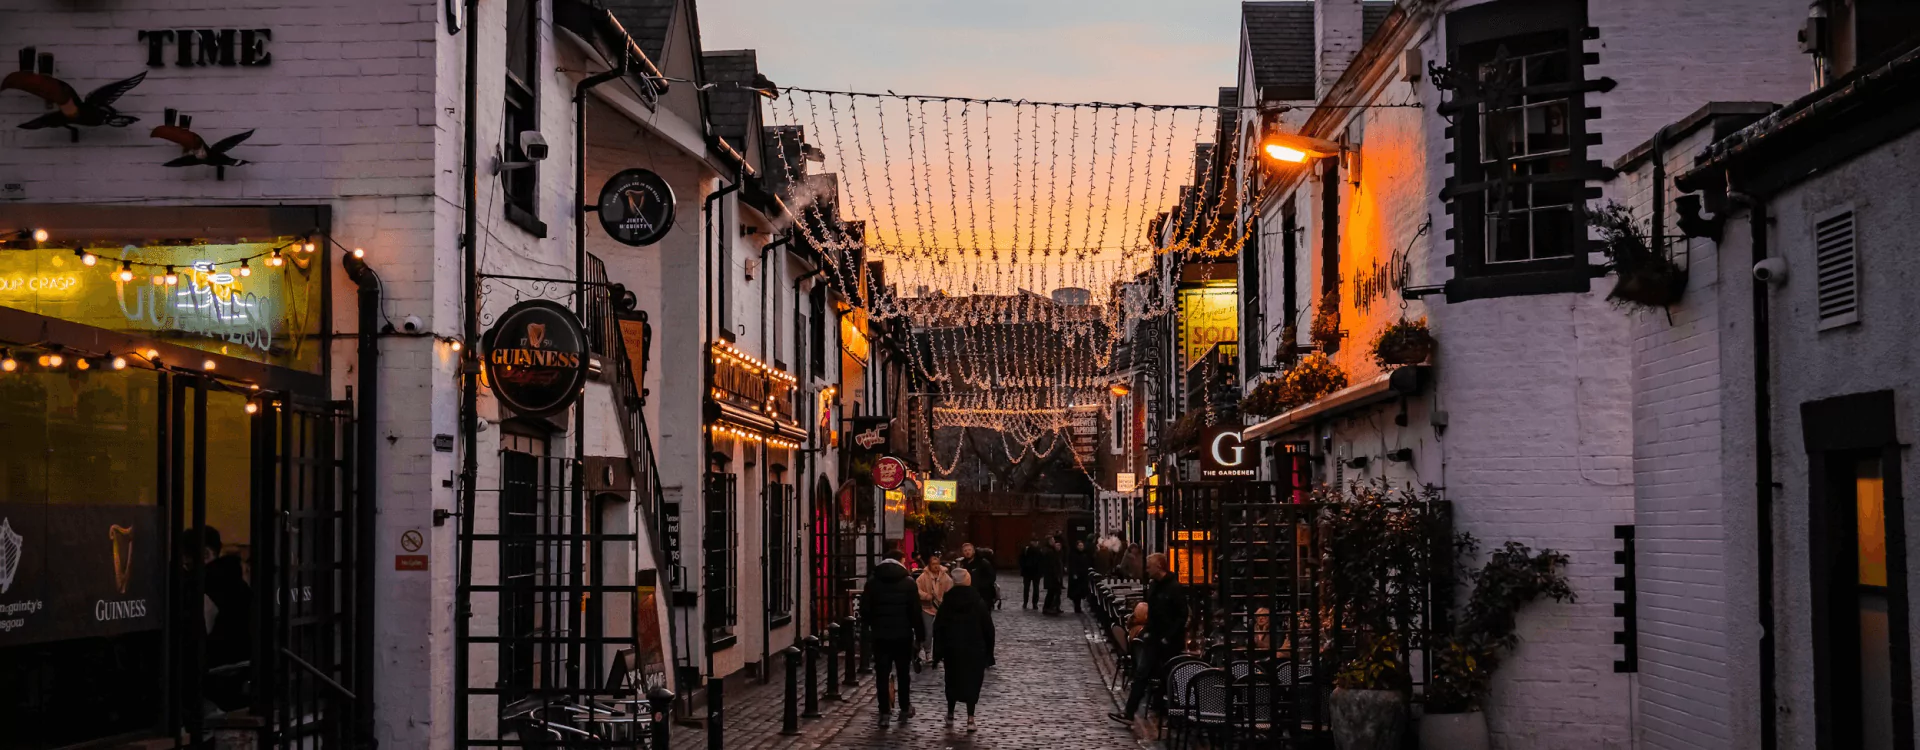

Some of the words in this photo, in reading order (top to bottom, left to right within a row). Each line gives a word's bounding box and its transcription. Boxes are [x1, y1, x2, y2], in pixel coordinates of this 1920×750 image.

[138, 29, 271, 67] TIME
[491, 348, 580, 369] GUINNESS
[1211, 431, 1246, 467] G
[1284, 444, 1308, 453] THE
[95, 599, 147, 622] GUINNESS
